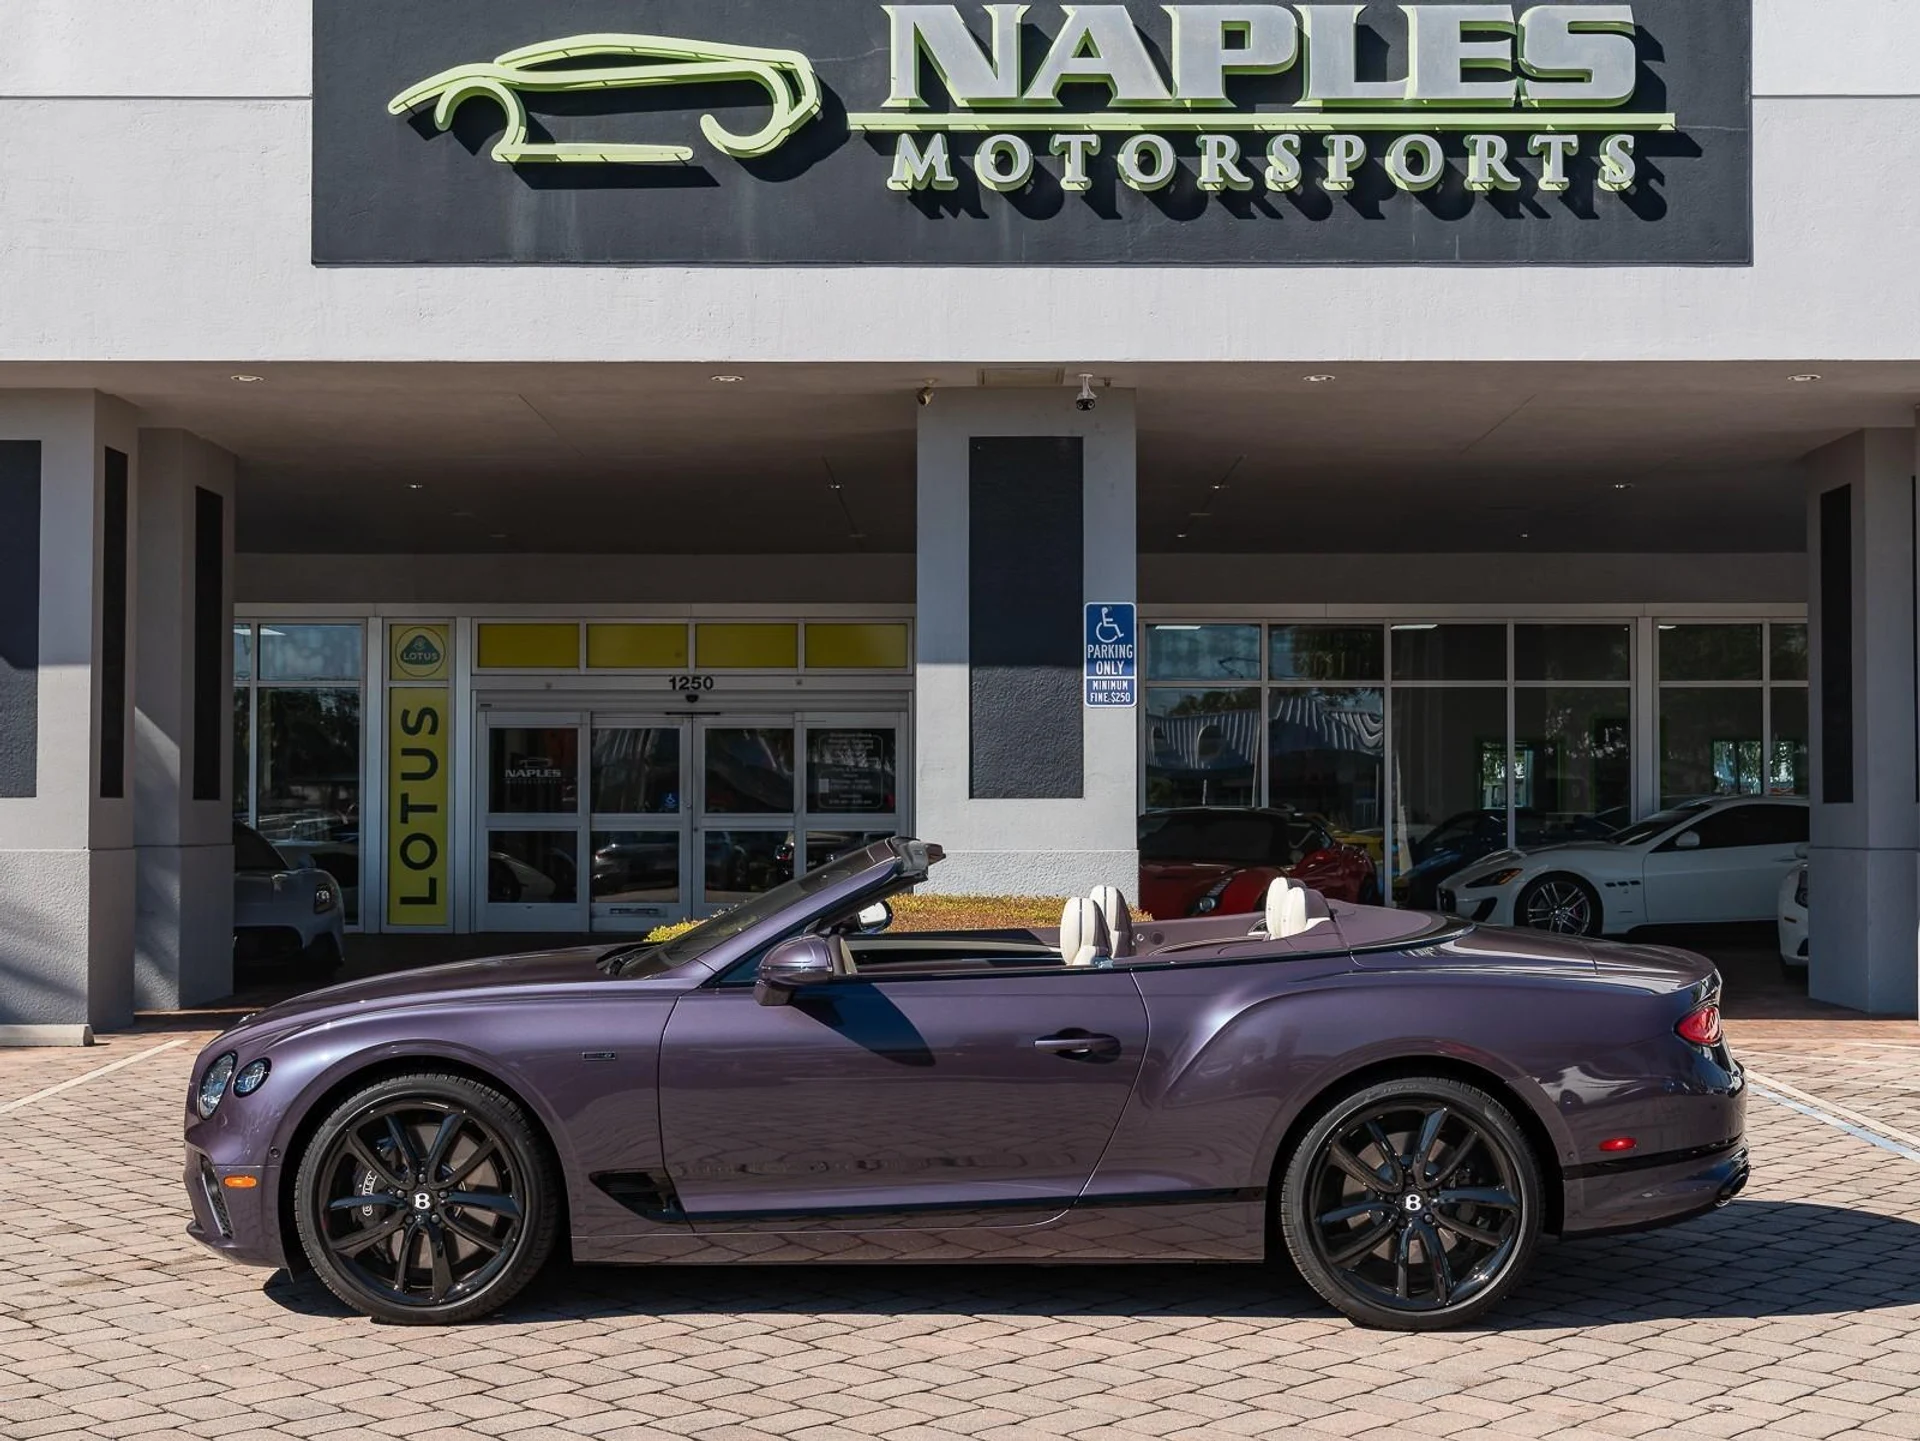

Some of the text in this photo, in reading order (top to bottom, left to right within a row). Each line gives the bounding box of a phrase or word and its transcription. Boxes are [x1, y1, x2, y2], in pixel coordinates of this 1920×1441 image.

[881, 4, 1637, 109] NAPLES
[886, 132, 1638, 192] MOTORSPORTS
[403, 651, 438, 661] LOTUS
[1087, 644, 1133, 659] PARKING
[1096, 660, 1124, 675] ONLY
[669, 675, 714, 691] 1250
[1092, 680, 1129, 691] MINIMUM
[1090, 691, 1131, 704] FINE $250
[504, 768, 562, 778] NAPLES
[399, 706, 439, 905] LOTUS
[414, 1192, 431, 1210] B
[1405, 1193, 1422, 1211] B
